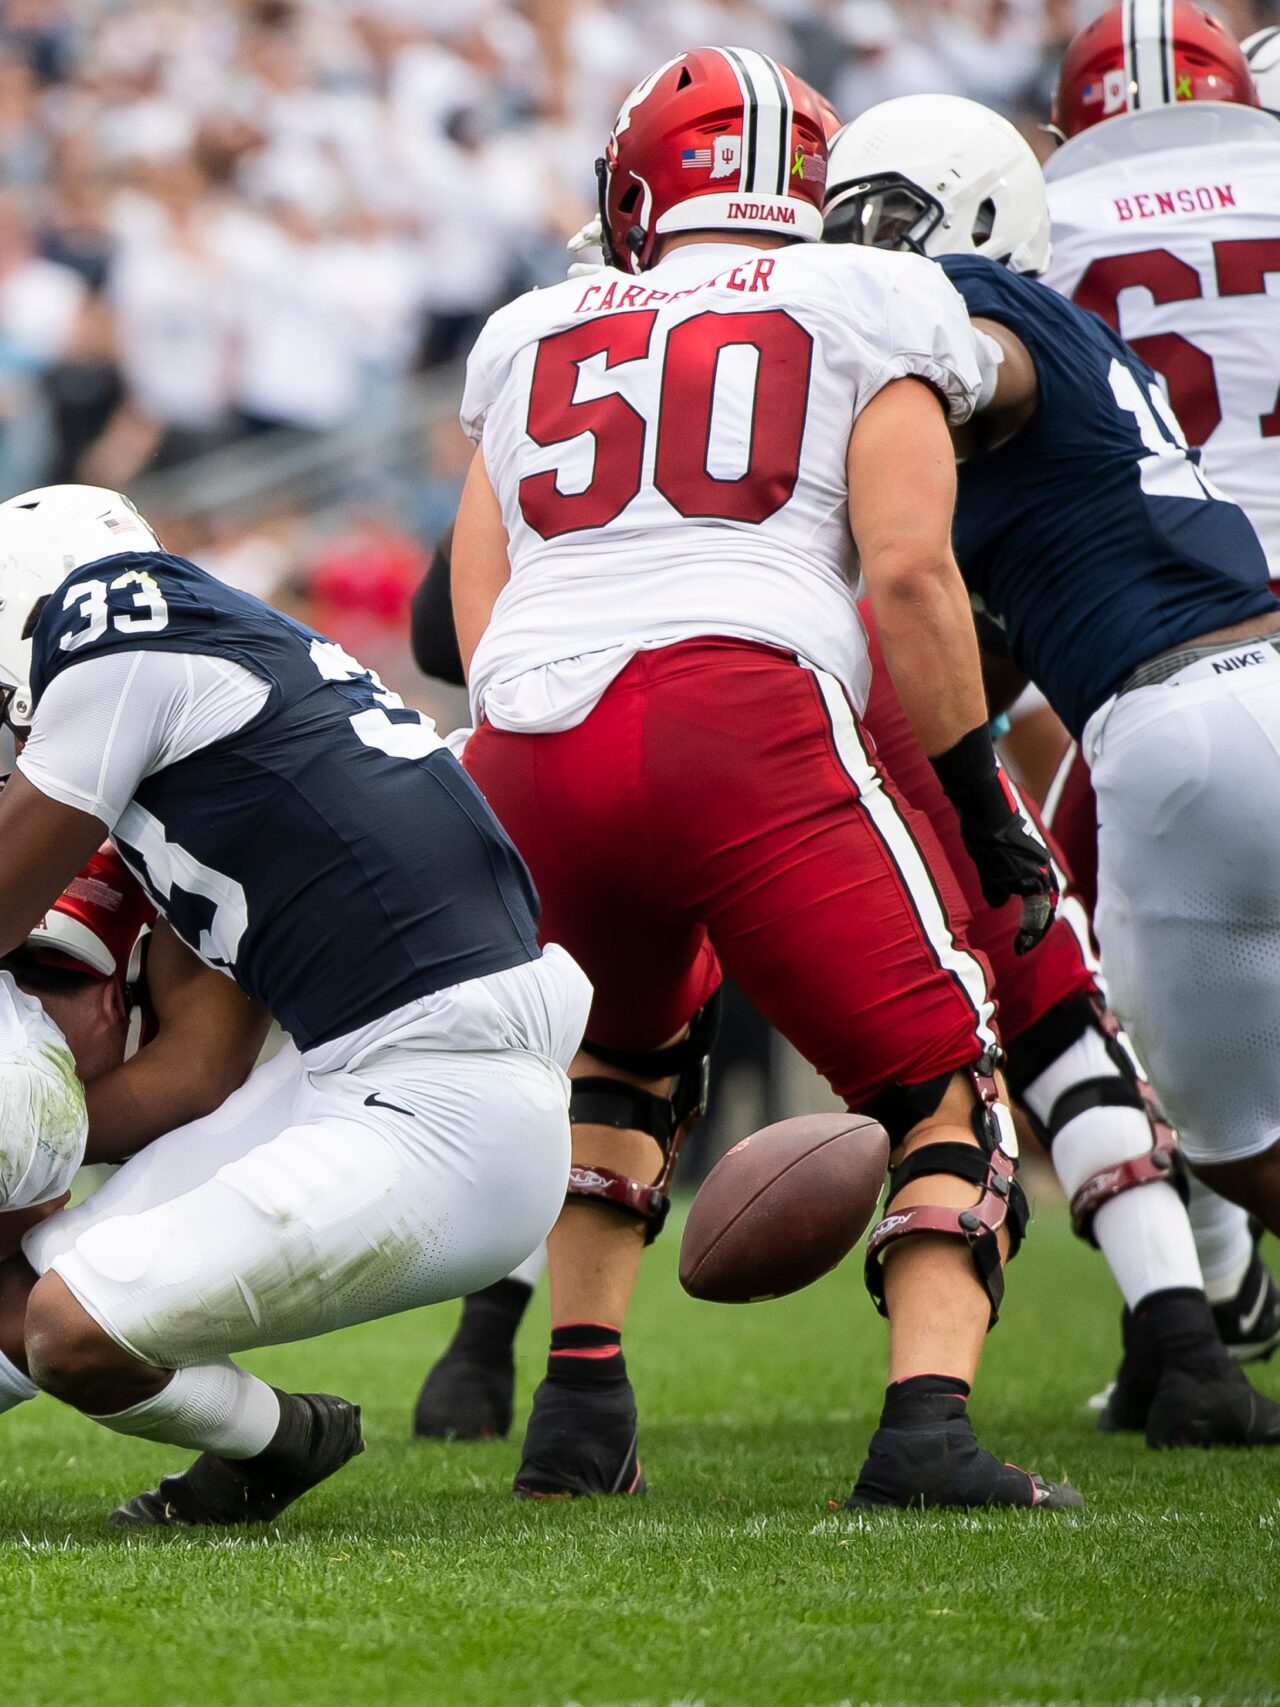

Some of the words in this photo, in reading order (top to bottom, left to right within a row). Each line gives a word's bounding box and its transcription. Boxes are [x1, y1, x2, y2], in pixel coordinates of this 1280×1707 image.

[726, 202, 796, 225] INDIANA
[1114, 184, 1237, 222] BENSON
[518, 308, 814, 541] 50
[59, 569, 169, 652] 33
[1211, 650, 1266, 675] NIKE
